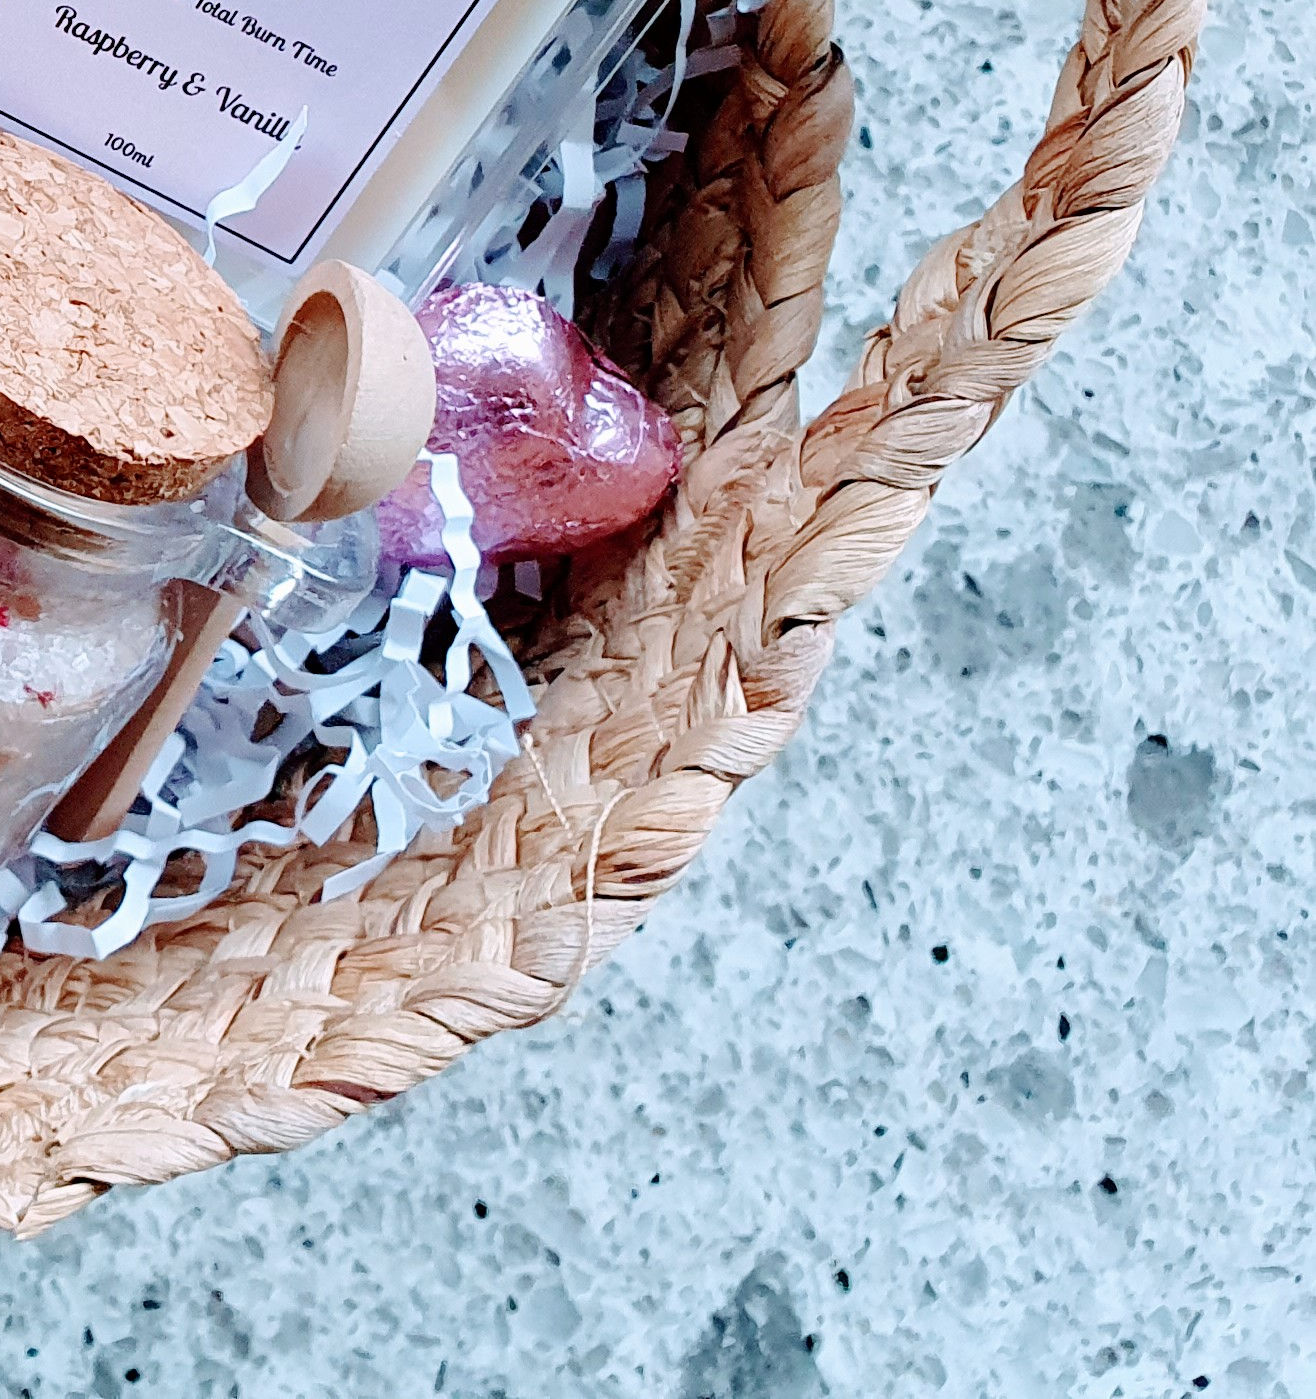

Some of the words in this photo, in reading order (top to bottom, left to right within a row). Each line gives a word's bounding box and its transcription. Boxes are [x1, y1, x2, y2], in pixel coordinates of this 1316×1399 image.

[55, 4, 178, 90] Raspberry
[182, 73, 206, 96] &
[216, 86, 302, 150] Vanill
[242, 16, 287, 52] Burn
[292, 41, 338, 79] Time
[104, 131, 154, 168] 100ml
